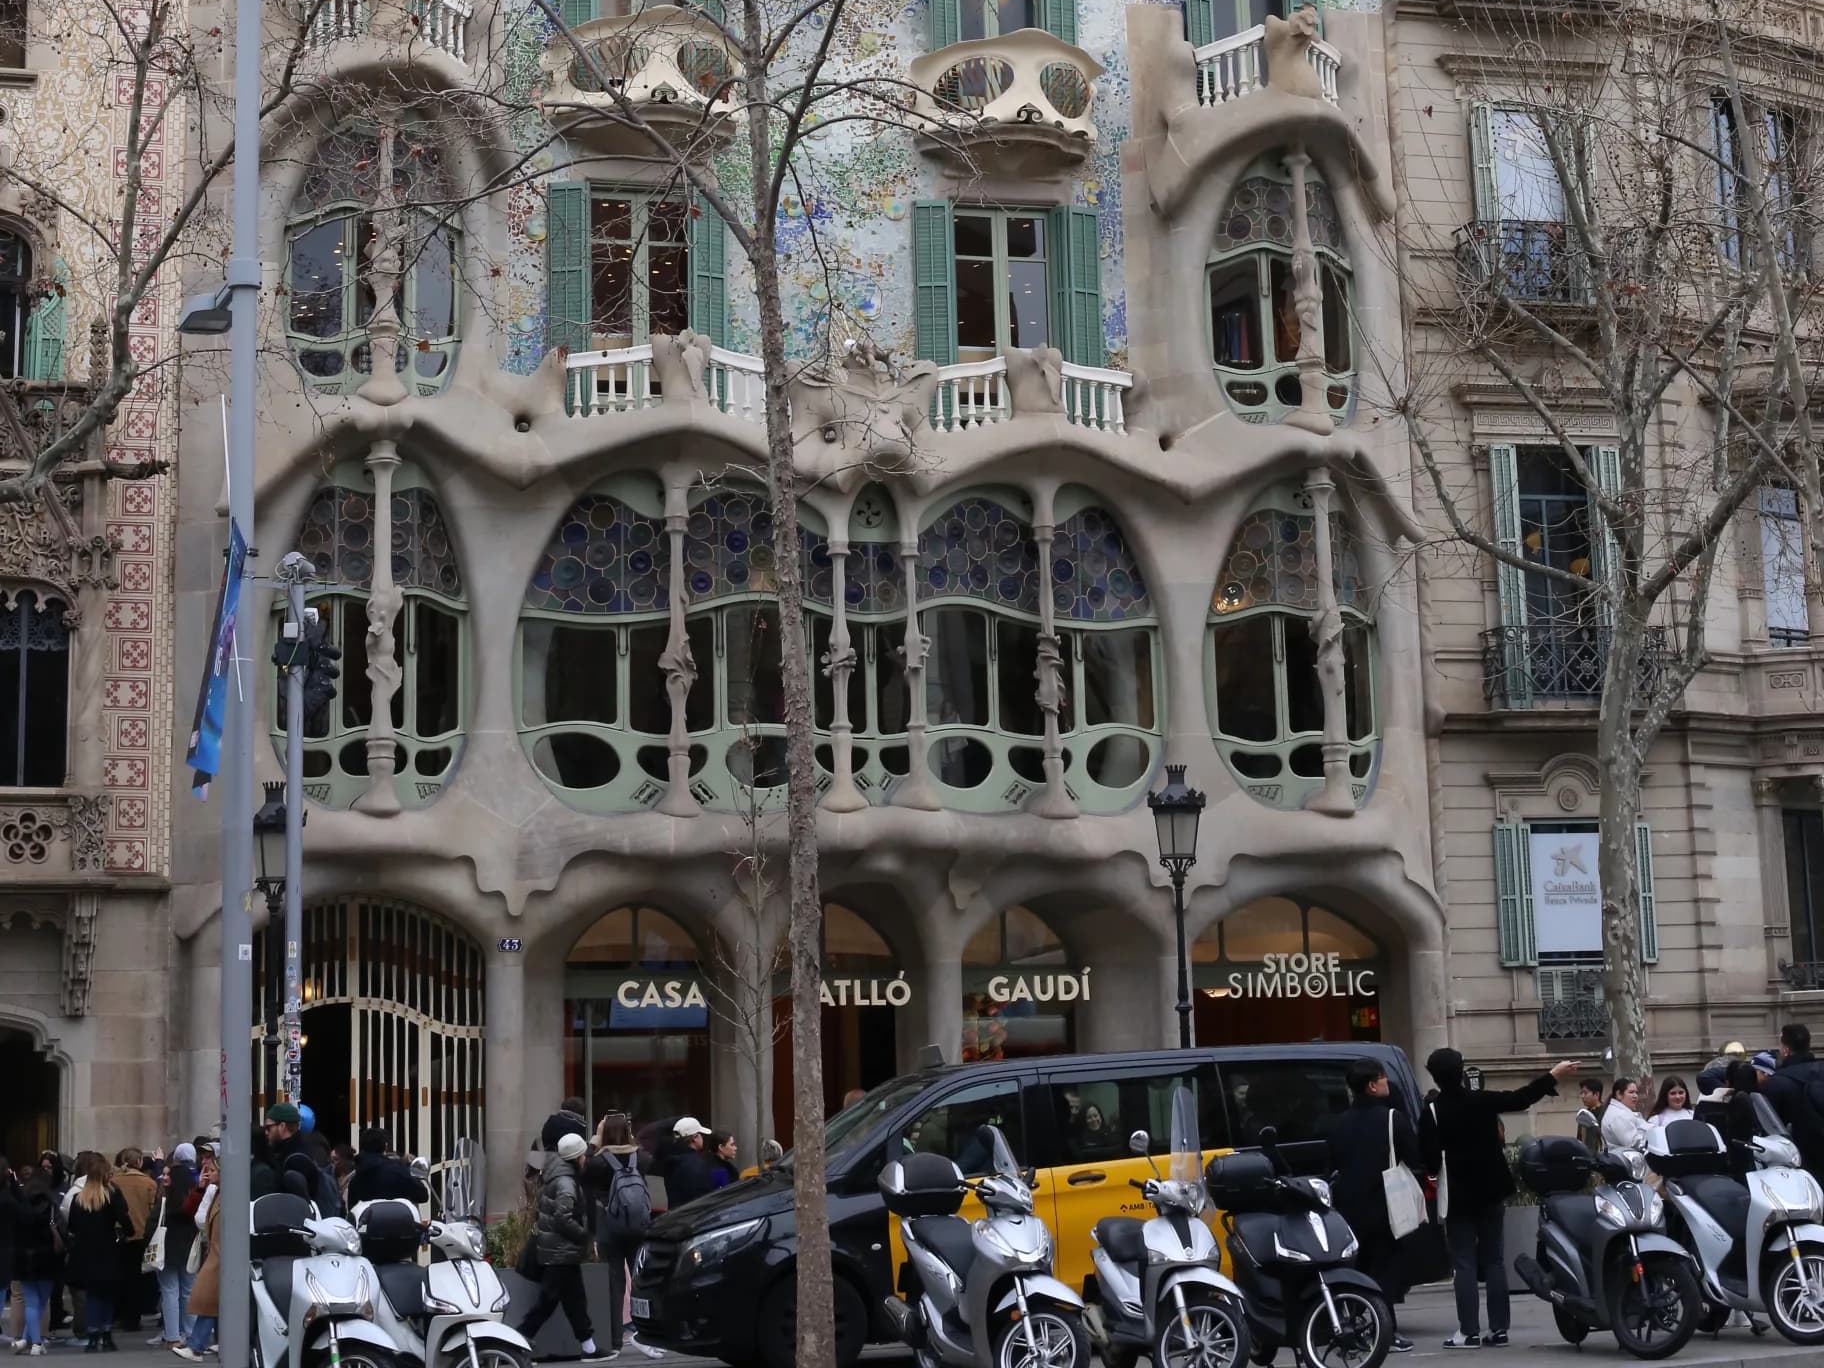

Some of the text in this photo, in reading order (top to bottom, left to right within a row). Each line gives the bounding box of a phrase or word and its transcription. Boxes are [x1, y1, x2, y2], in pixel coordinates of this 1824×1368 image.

[1543, 881, 1596, 892] CaixaBank
[1263, 952, 1341, 974] STORE
[617, 966, 1091, 1008] CASA ATLLÓ GAUDÍ
[1228, 970, 1376, 998] SIMBOLIC
